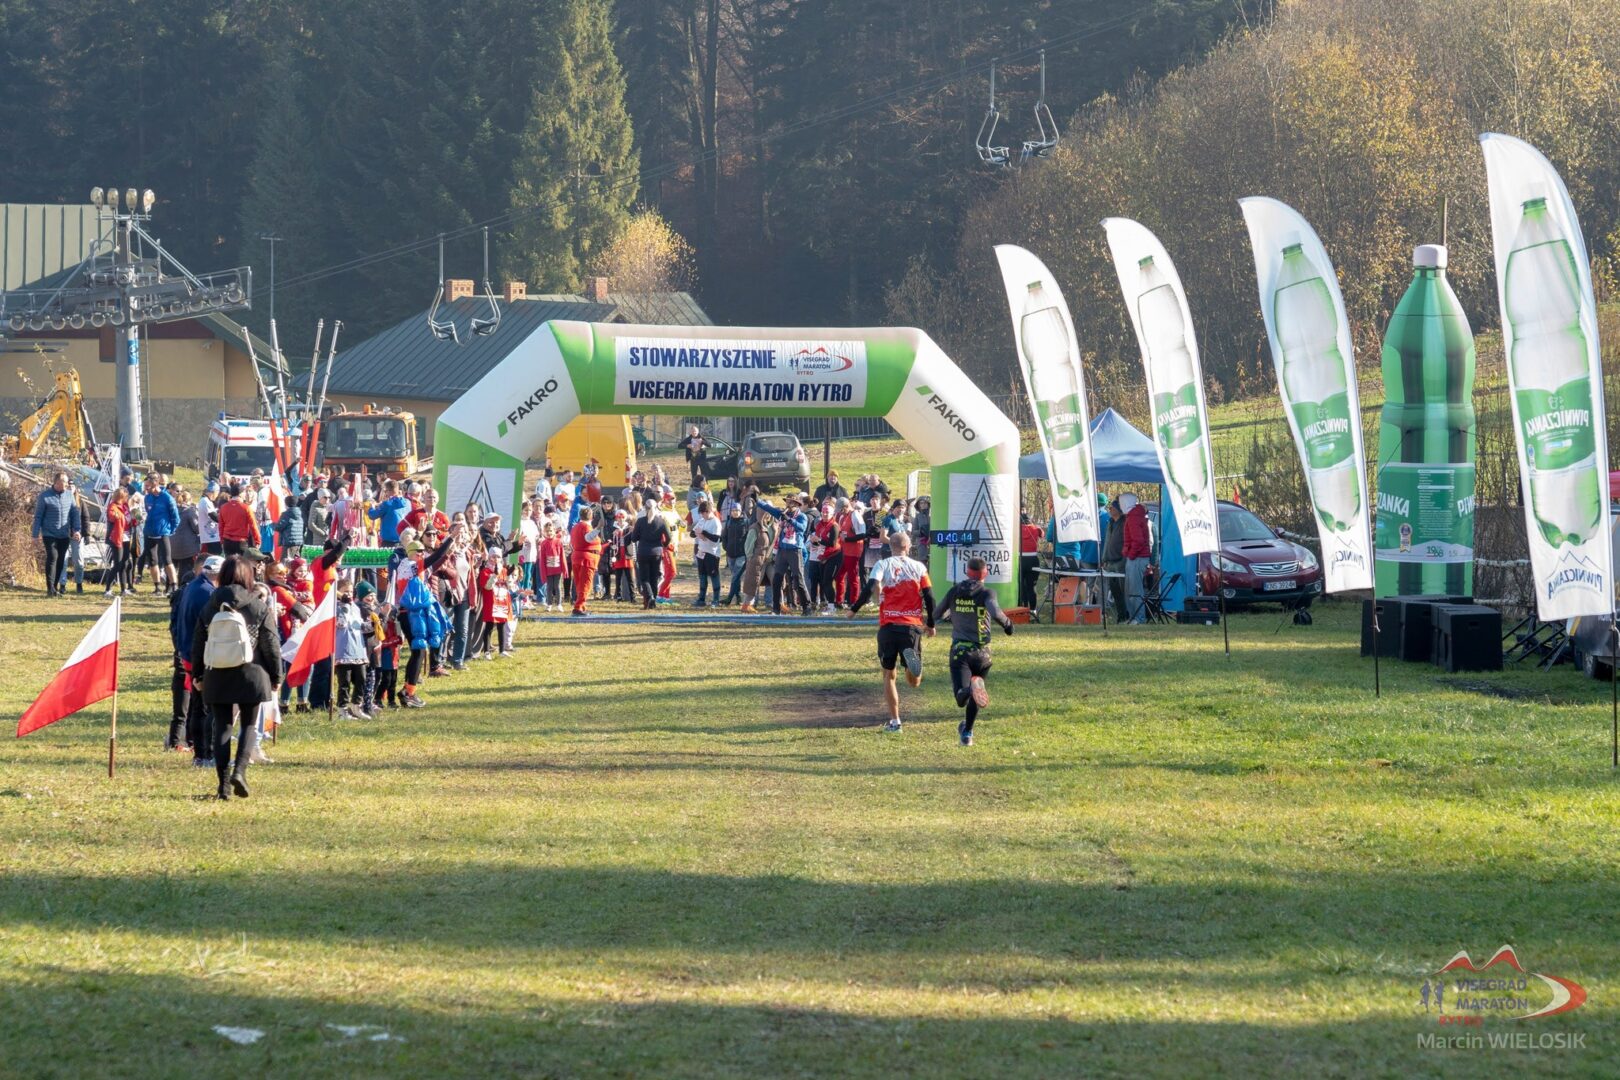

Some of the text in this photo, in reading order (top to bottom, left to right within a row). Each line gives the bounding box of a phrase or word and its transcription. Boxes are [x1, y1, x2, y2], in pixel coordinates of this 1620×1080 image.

[629, 347, 777, 369] STOWARZYSZENIE
[507, 379, 558, 425] FAKRO
[628, 380, 852, 402] VISEGRAD MARATON RYTRO
[928, 394, 976, 442] FAKRO
[963, 564, 1001, 576] URA
